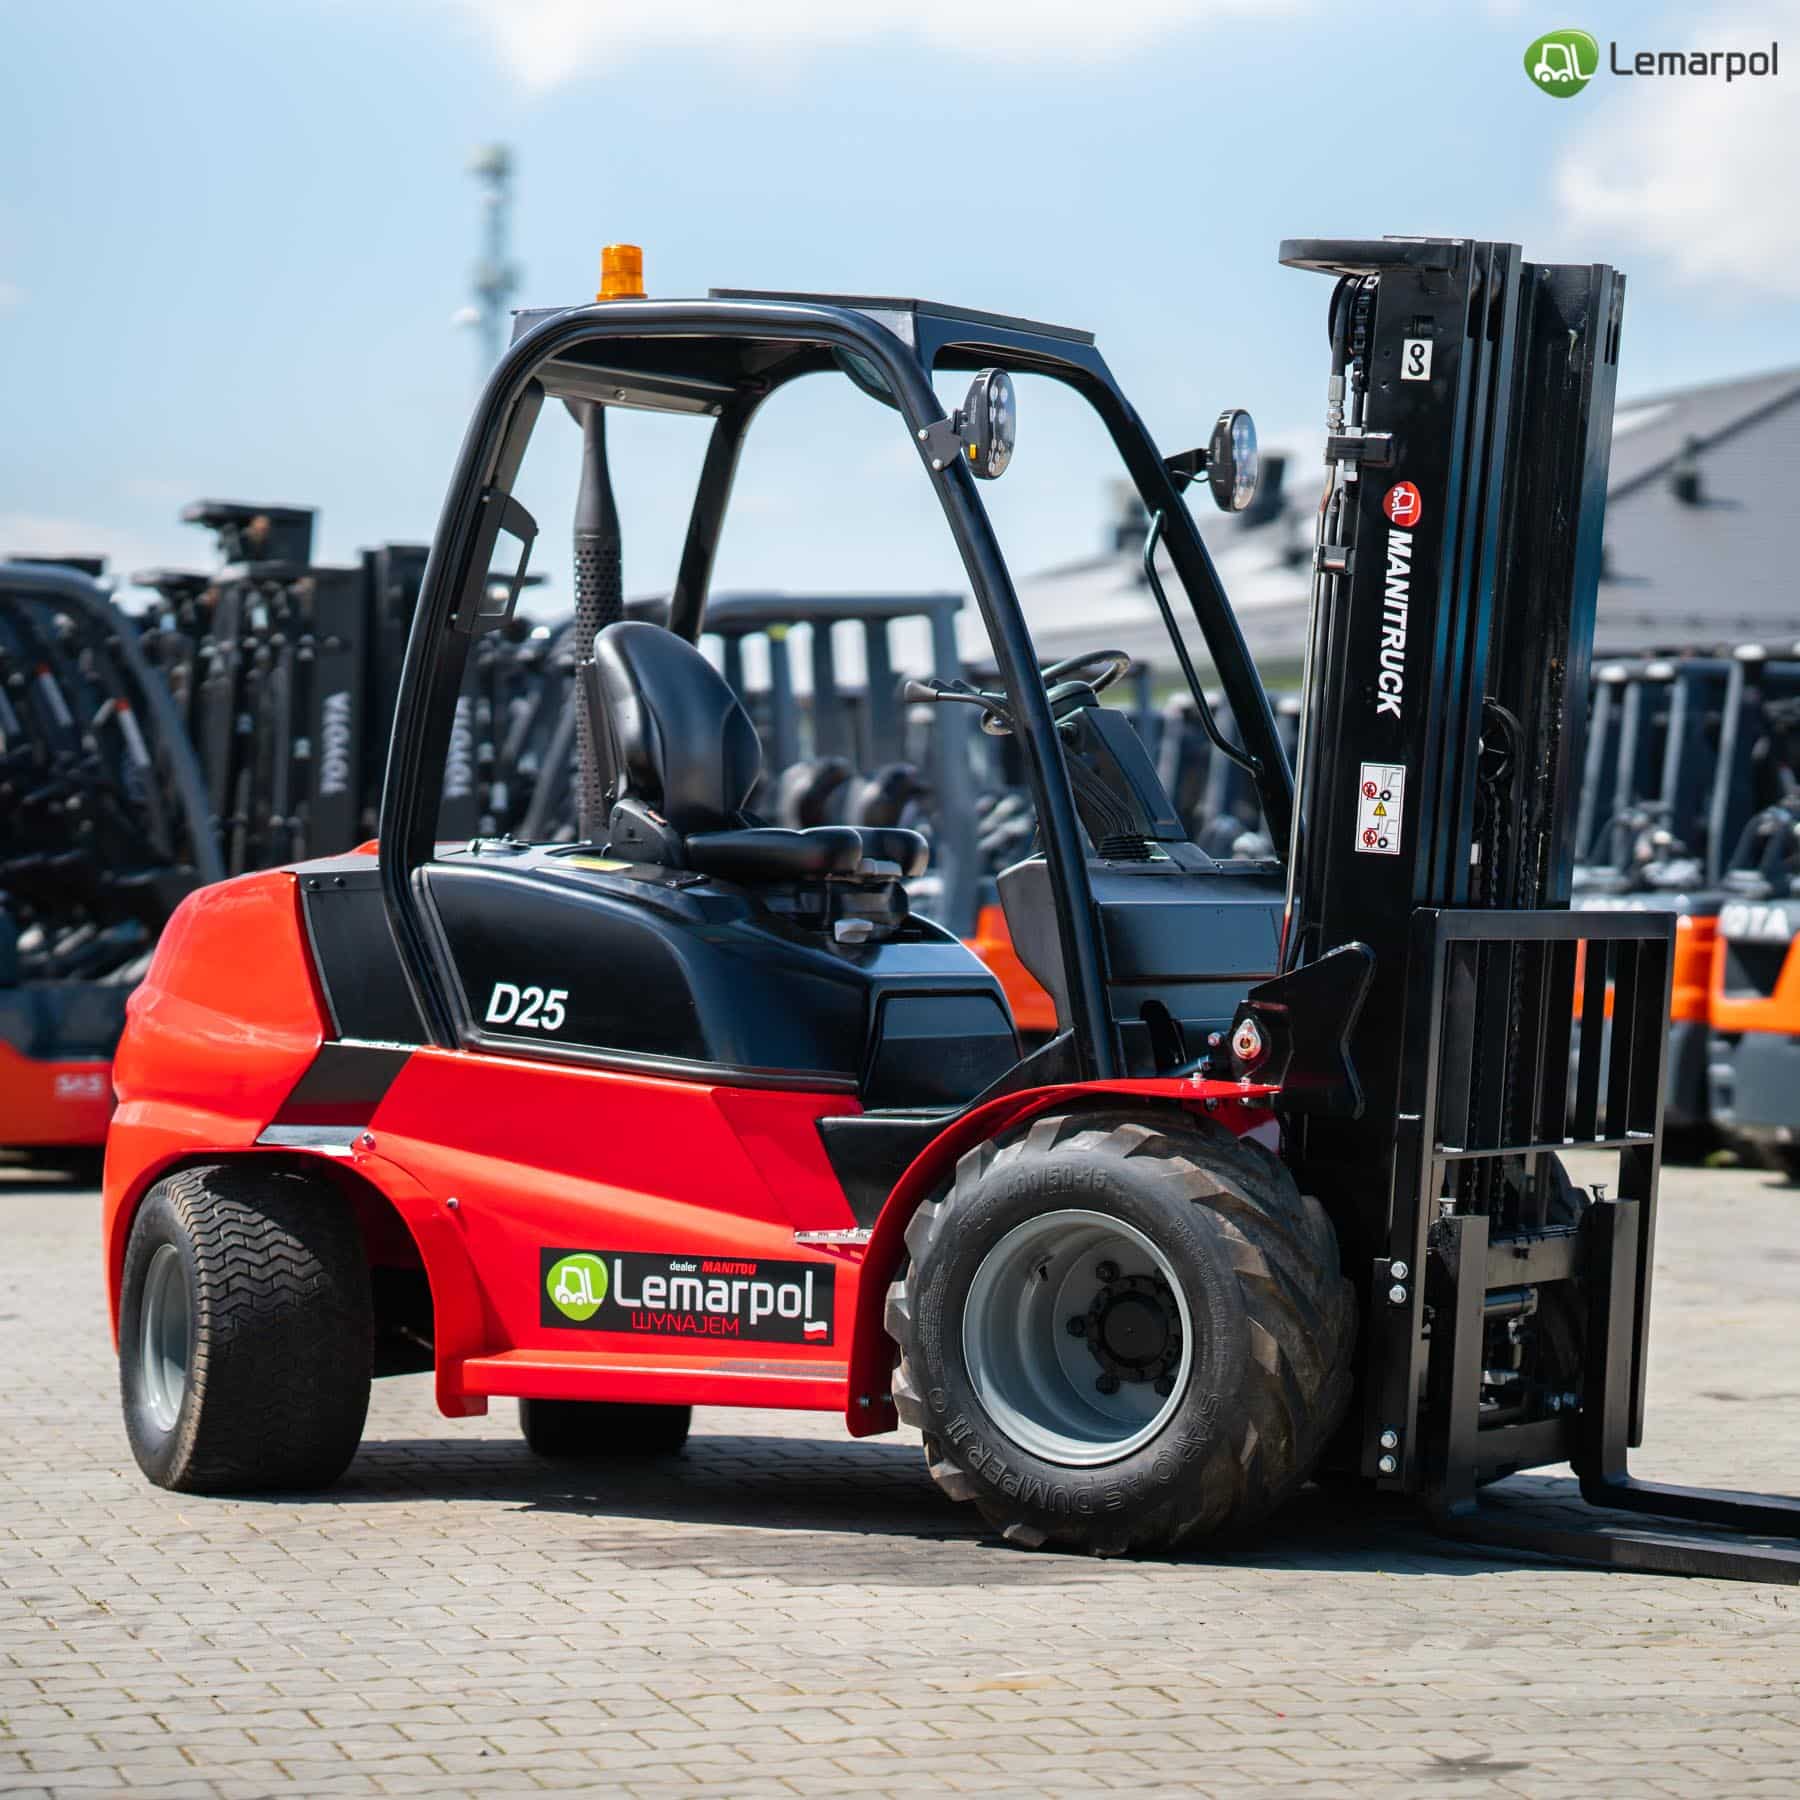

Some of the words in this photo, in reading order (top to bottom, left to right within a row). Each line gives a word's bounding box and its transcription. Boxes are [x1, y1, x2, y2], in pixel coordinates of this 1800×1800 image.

[1376, 529, 1413, 719] MANITRUCK
[485, 982, 569, 1031] D25
[614, 1259, 813, 1325] Lemarpol
[669, 1261, 697, 1272] dealer
[702, 1261, 757, 1275] MANITOU
[632, 1311, 739, 1336] WYNAJEM
[967, 1441, 1098, 1516] DUMPER
